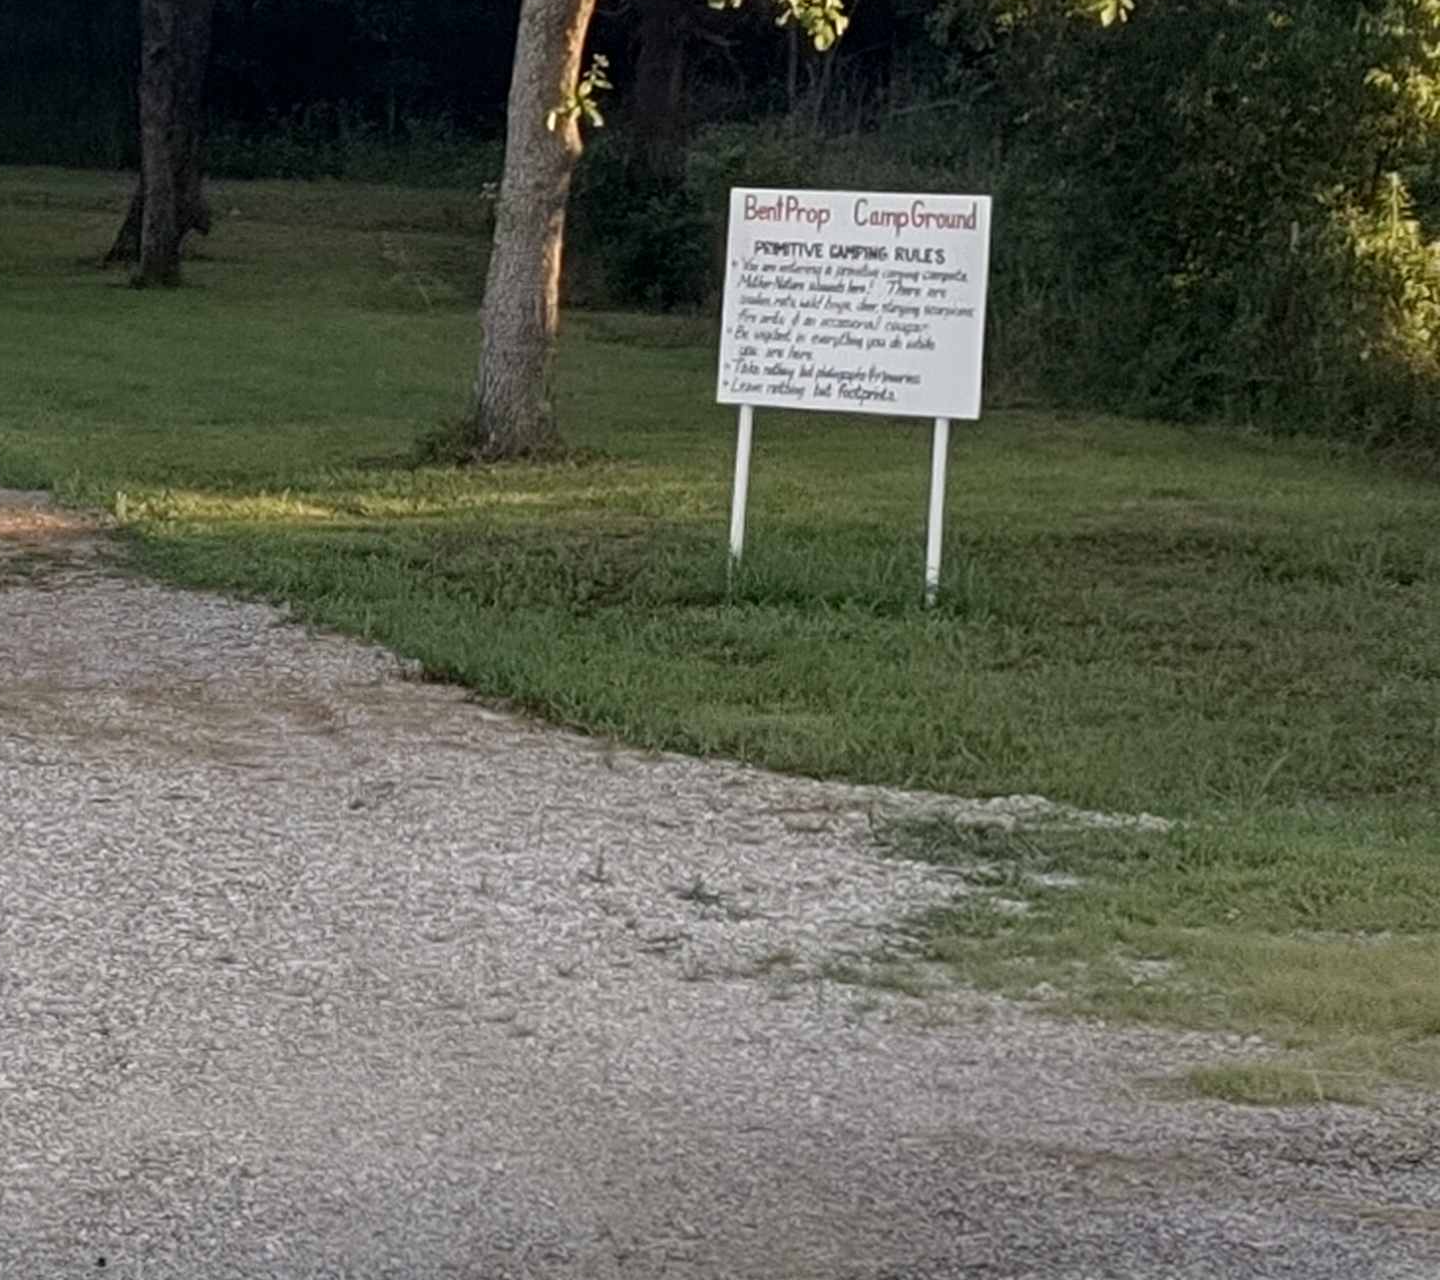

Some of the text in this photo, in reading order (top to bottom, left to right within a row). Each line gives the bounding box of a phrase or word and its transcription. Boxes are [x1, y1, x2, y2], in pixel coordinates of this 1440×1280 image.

[754, 240, 946, 264] PRIMITIVE CAMPING RULES
[741, 257, 759, 271] You
[762, 264, 776, 272] are
[779, 261, 820, 277] entering
[887, 279, 920, 293] There
[927, 288, 946, 297] are
[734, 325, 749, 339] Be
[811, 331, 863, 349] everything
[866, 338, 886, 351] you
[889, 332, 902, 348] do
[739, 346, 757, 359] you
[766, 348, 782, 358] are
[732, 357, 760, 375] Take
[799, 364, 814, 377] but
[731, 377, 763, 393] Leave
[767, 381, 805, 400] nothing
[813, 383, 831, 397] but
